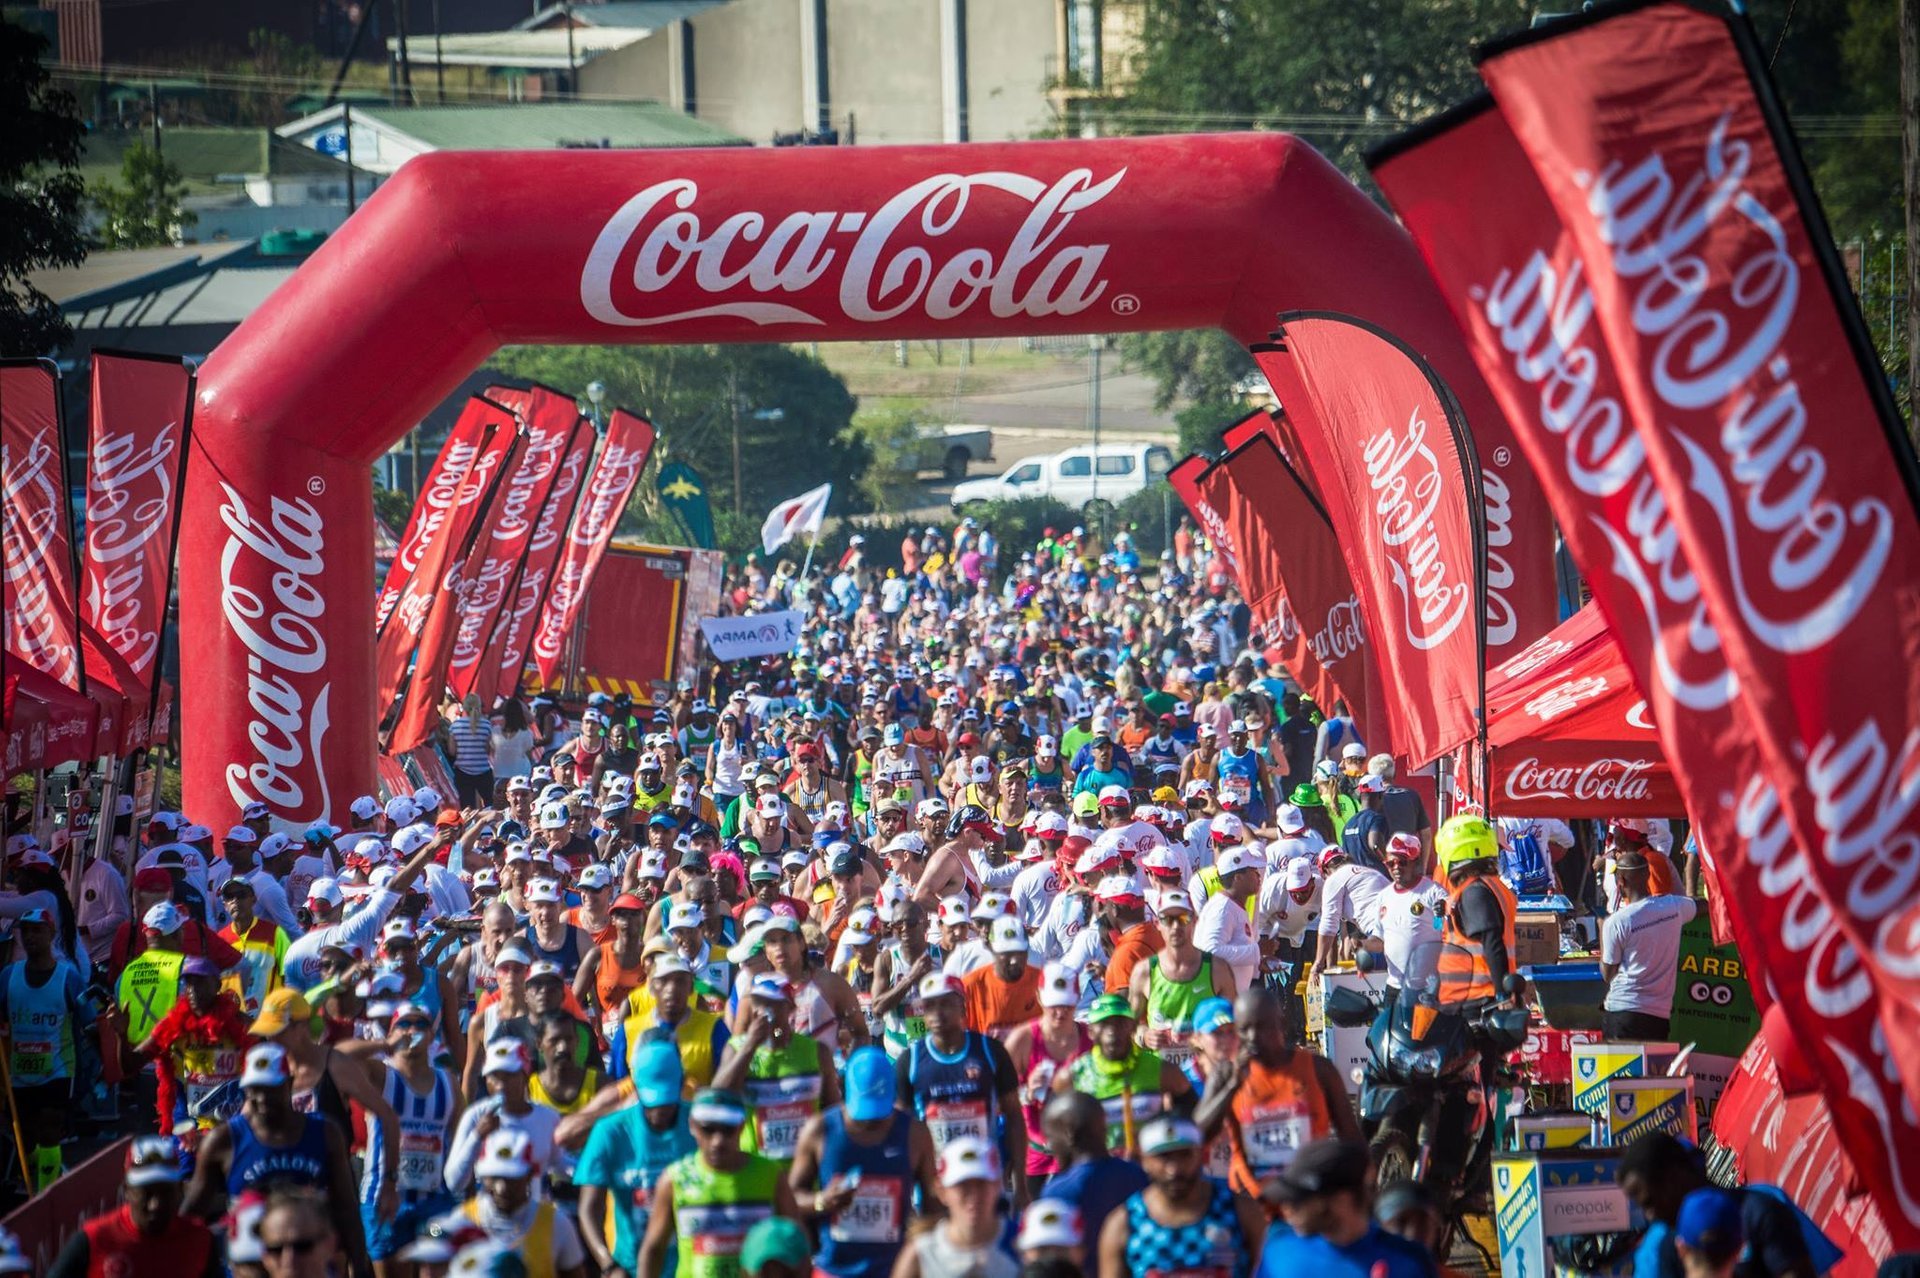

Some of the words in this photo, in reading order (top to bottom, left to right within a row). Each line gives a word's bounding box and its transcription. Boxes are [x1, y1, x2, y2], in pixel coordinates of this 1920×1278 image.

[580, 167, 1128, 327] Coca-Cola
[219, 481, 331, 832] Coca-Cola
[1505, 757, 1656, 801] Coca-Cola
[1680, 953, 1748, 981] ARB
[1553, 1198, 1615, 1217] neopak
